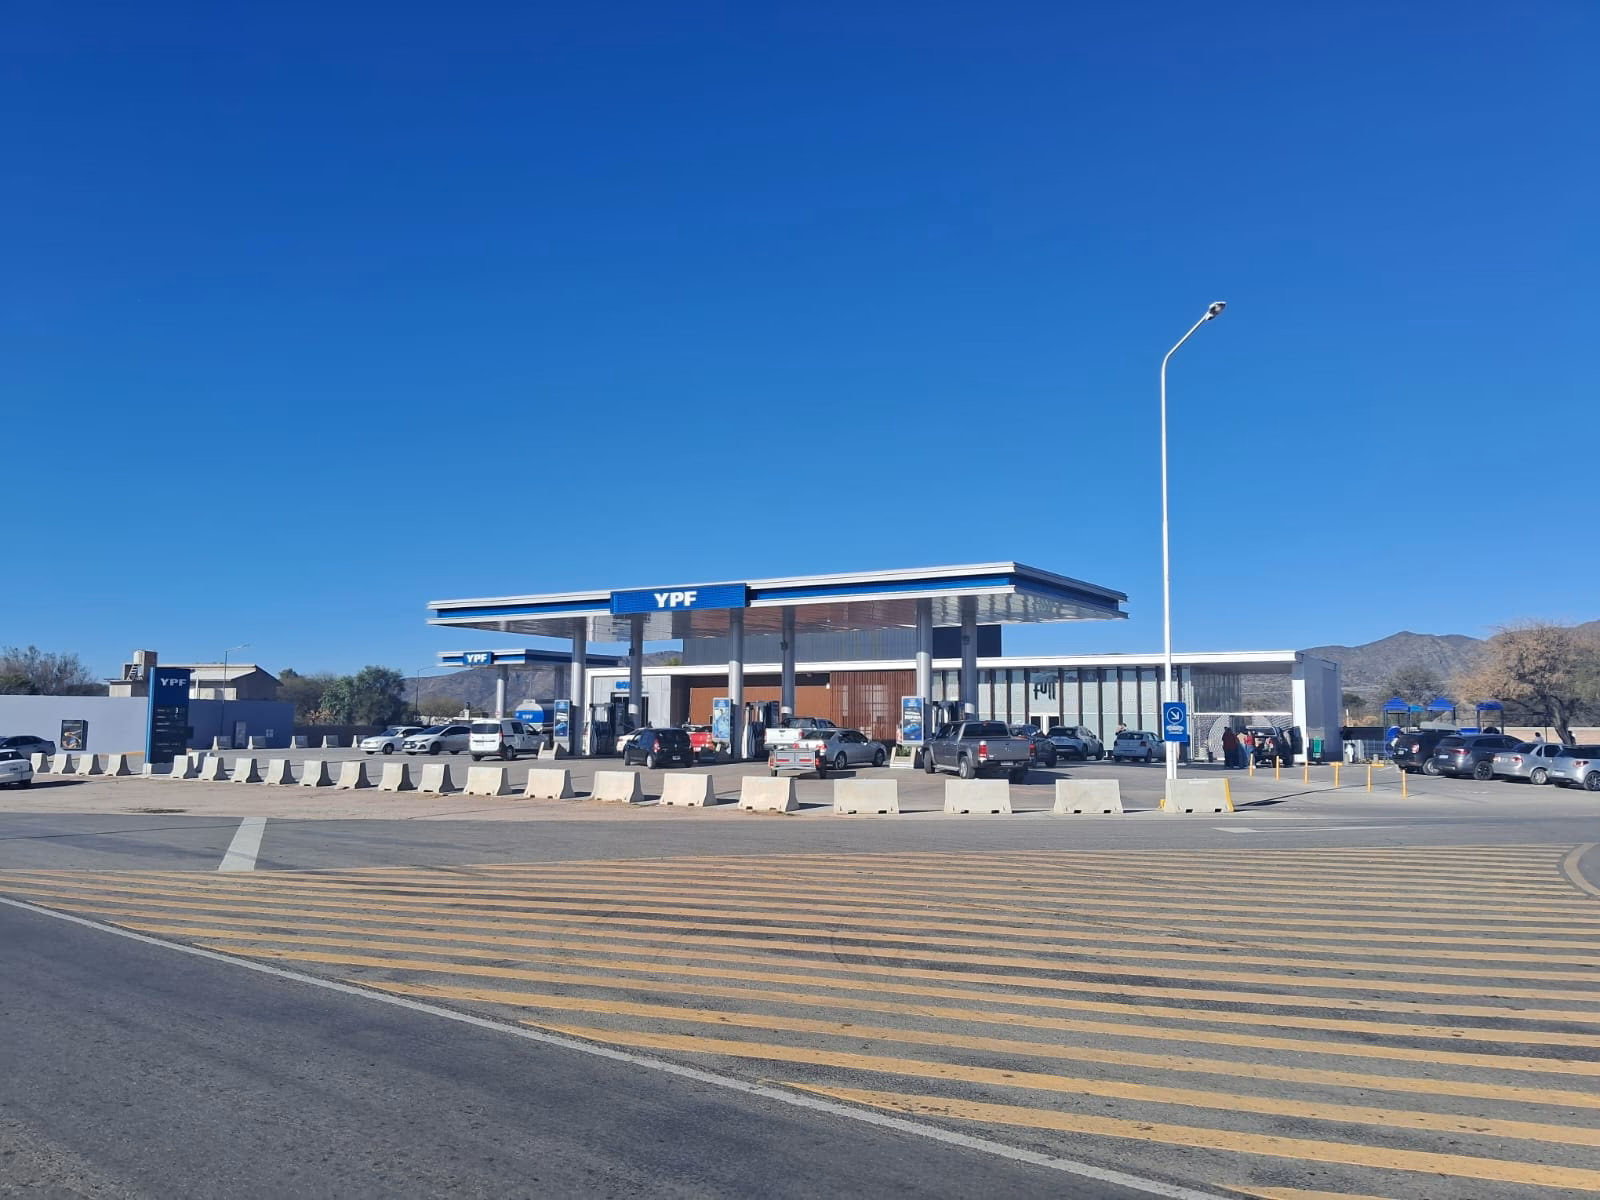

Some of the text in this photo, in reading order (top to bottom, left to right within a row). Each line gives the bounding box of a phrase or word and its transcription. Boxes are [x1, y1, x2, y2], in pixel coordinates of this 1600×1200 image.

[654, 591, 697, 608] YPF
[467, 654, 487, 663] YPF
[160, 678, 187, 686] YPF
